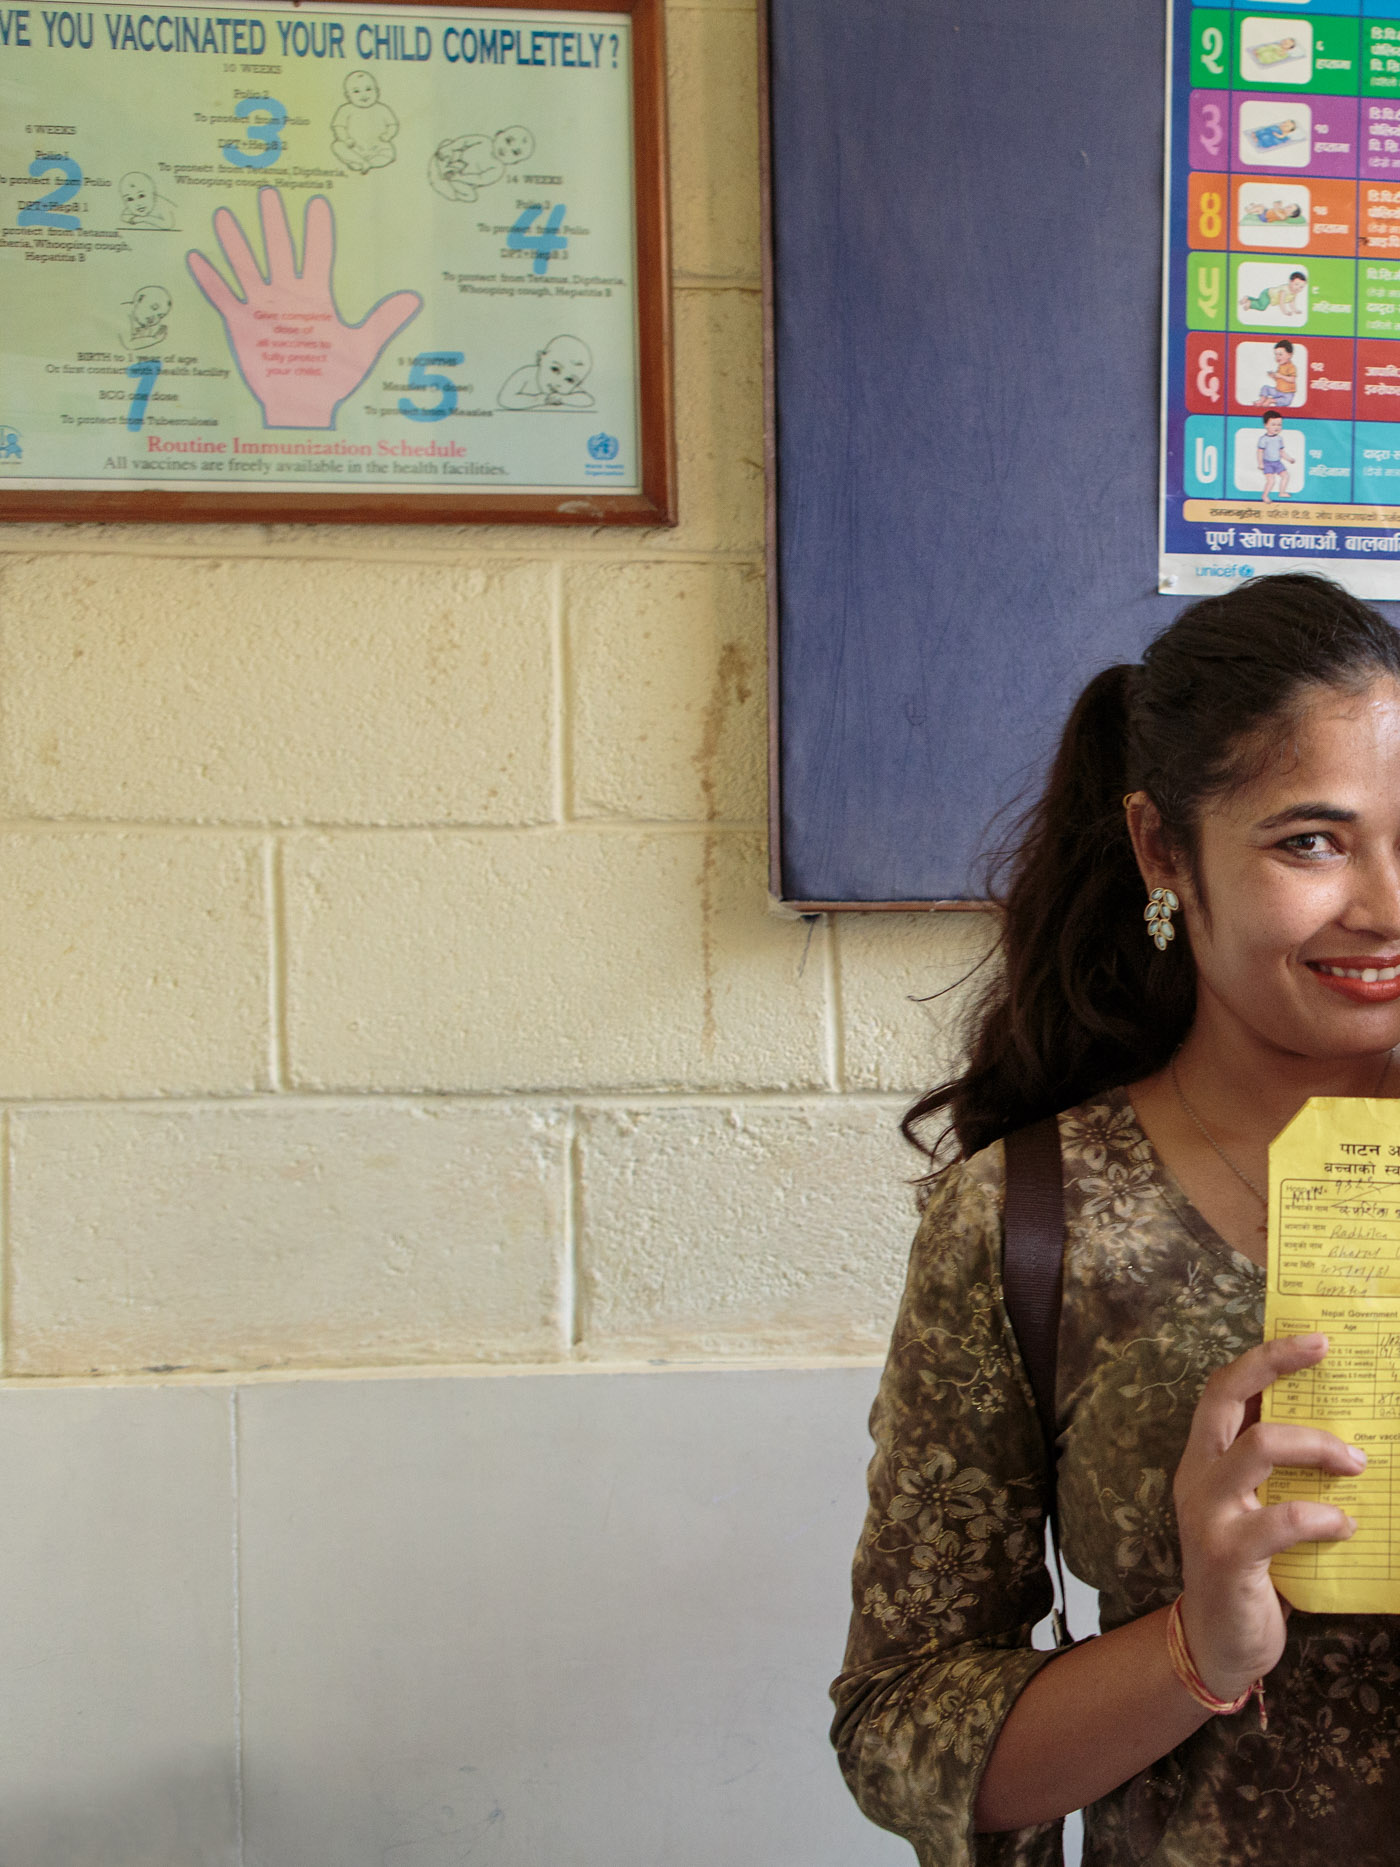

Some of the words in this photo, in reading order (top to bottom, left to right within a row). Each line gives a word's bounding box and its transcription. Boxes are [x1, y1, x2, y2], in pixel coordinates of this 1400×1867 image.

[41, 11, 94, 49] YOU
[104, 14, 266, 55] VACCINATED
[276, 20, 346, 59] YOUR
[356, 24, 432, 62] CHILD
[1201, 27, 1224, 74] २
[223, 63, 236, 73] 10
[240, 64, 283, 74] WEEKS
[233, 89, 259, 100] Polio
[193, 112, 207, 123] To
[210, 113, 250, 125] protect
[254, 114, 281, 125] from
[284, 115, 311, 126] Polio
[25, 125, 33, 134] 6
[34, 125, 77, 135] WEEKS
[221, 96, 287, 169] 3
[1199, 104, 1223, 156] ३
[158, 162, 172, 172] To
[174, 163, 214, 175] protect
[218, 164, 245, 174] from
[9, 176, 51, 187] protect
[55, 176, 82, 186] from
[84, 177, 112, 187] Polio
[174, 175, 233, 188] Whooping
[275, 179, 324, 190] Hepatitis
[326, 180, 333, 189] B
[506, 175, 519, 184] 14
[522, 174, 563, 185] WEEKS
[16, 153, 83, 231] 2
[1199, 191, 1222, 239] ४
[2, 227, 43, 237] protect
[47, 227, 75, 237] from
[477, 222, 490, 232] To
[493, 224, 531, 235] protect
[536, 225, 561, 235] from
[563, 226, 590, 235] Polio
[33, 239, 92, 252] Whooping
[506, 203, 568, 275] 4
[25, 251, 76, 263] Hepatitis
[78, 253, 86, 262] B
[442, 271, 455, 281] To
[458, 273, 497, 283] protect
[501, 273, 525, 283] from
[458, 284, 515, 296] Whooping
[555, 287, 603, 298] Hepatitis
[605, 288, 612, 297] B
[1197, 267, 1220, 319] ५
[77, 352, 112, 362] BIRTH
[113, 353, 125, 362] to
[135, 354, 161, 364] year
[164, 354, 176, 363] of
[178, 356, 197, 366] age
[45, 364, 60, 373] Or
[63, 365, 86, 374] first
[87, 366, 127, 375] contact
[128, 366, 153, 375] with
[157, 367, 190, 376] health
[192, 367, 231, 379] facility
[1196, 349, 1220, 403] ६
[397, 351, 465, 423] 5
[98, 390, 125, 400] BCG
[128, 393, 149, 401] one
[152, 391, 178, 401] dose
[125, 359, 163, 432] 1
[364, 406, 377, 415] To
[60, 414, 75, 424] To
[77, 416, 117, 426] protect
[119, 416, 144, 425] from
[147, 416, 218, 426] Tuberculosis
[146, 435, 227, 454] Routine
[232, 437, 372, 457] Immunization
[376, 439, 467, 458] Schedule
[104, 456, 127, 470] All
[132, 457, 197, 472] vaccines
[201, 460, 223, 471] are
[228, 457, 271, 475] freely
[276, 459, 343, 473] available
[348, 460, 362, 473] in
[366, 460, 389, 474] the
[392, 461, 439, 475] health
[442, 461, 509, 476] facilities.
[1195, 437, 1218, 484] ७
[1205, 528, 1236, 551] पूर्ण
[1239, 527, 1275, 549] खोप
[1195, 563, 1237, 578] unicef
[1339, 1142, 1381, 1157] पाटन
[1323, 1160, 1376, 1175] बच्चाको
[1321, 1309, 1345, 1320] Nepal
[1347, 1309, 1398, 1319] Government
[1343, 1324, 1357, 1332] Age
[1353, 1432, 1377, 1441] Other
